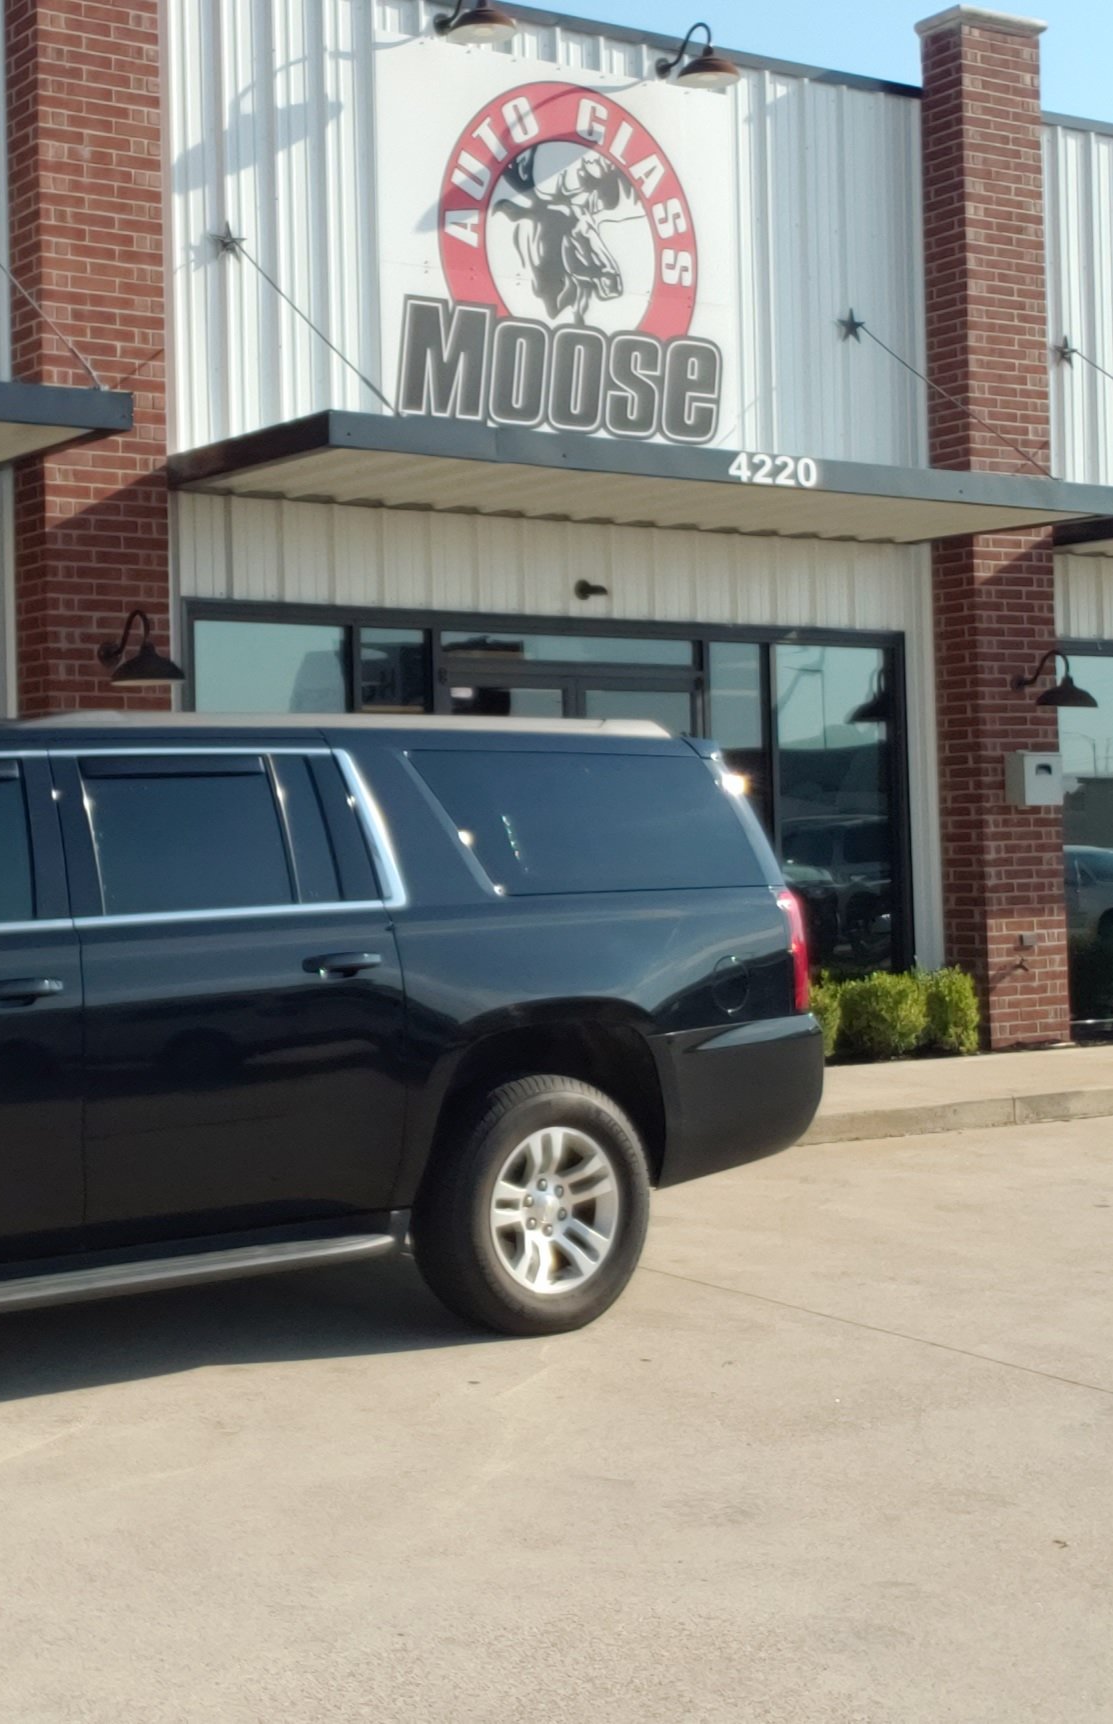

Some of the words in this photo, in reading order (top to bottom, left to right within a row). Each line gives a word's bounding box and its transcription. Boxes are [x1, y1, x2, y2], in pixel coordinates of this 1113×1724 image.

[444, 96, 540, 248] AUTO
[576, 98, 693, 288] GLASS
[729, 452, 818, 487] 4220
